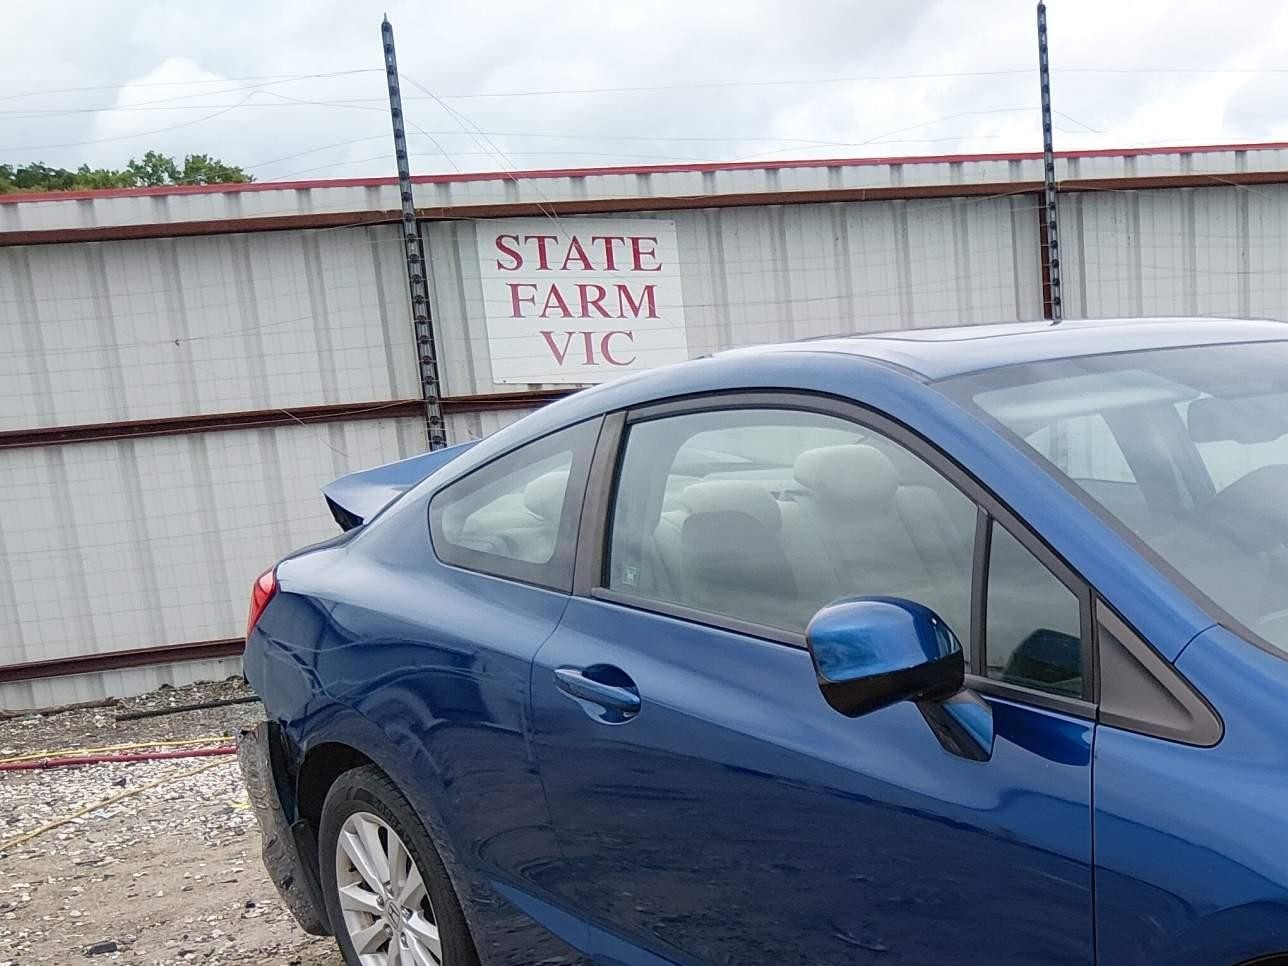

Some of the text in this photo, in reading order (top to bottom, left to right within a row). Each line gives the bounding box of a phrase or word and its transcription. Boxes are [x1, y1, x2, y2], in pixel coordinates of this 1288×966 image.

[495, 234, 663, 272] STATE
[506, 283, 660, 319] FARM
[540, 330, 636, 366] VIC
